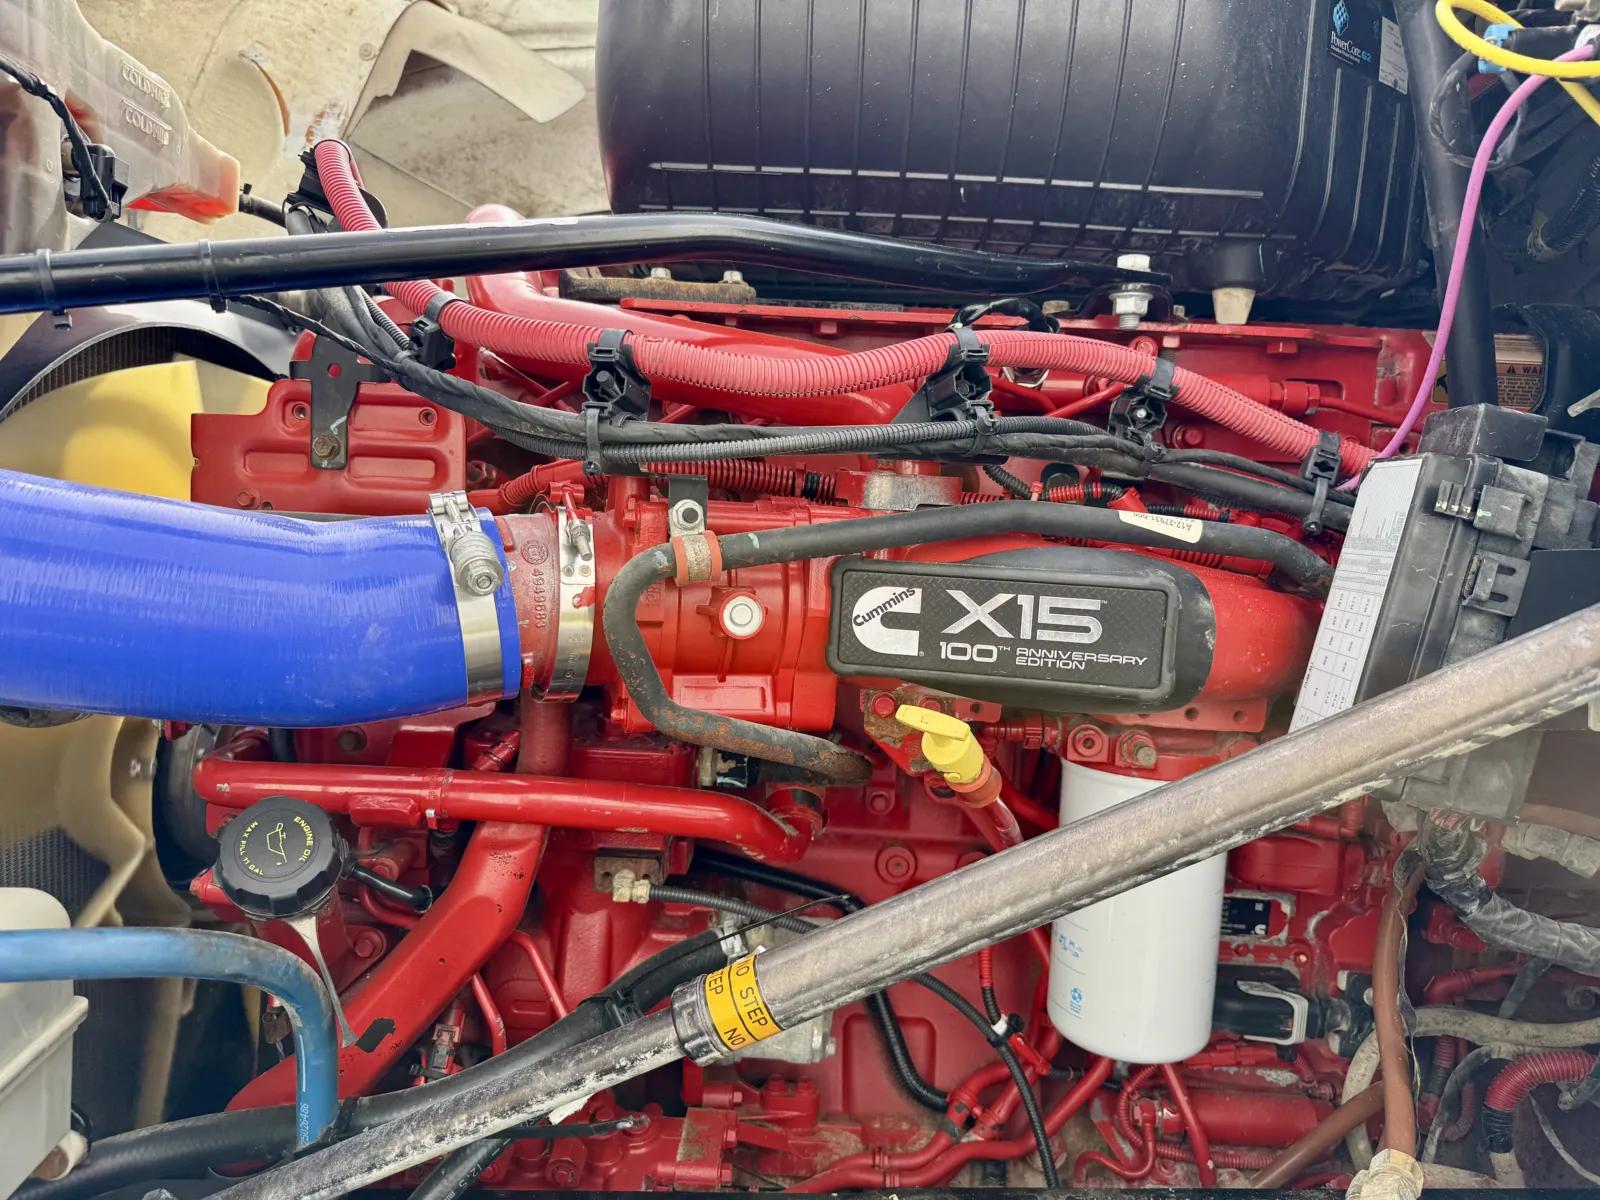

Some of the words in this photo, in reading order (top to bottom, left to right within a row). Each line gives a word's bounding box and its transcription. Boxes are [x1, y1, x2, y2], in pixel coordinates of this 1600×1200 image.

[852, 587, 916, 628] Cummins
[940, 589, 1103, 644] X15
[1015, 656, 1087, 670] EDITION
[1016, 647, 1148, 666] ANNIVERSARY
[243, 821, 259, 838] MAX
[293, 816, 314, 846] ENGINE
[298, 849, 311, 862] OIL
[248, 864, 264, 876] GAL
[708, 970, 724, 995] TEP
[724, 1027, 746, 1046] NO
[740, 987, 768, 1027] STEP
